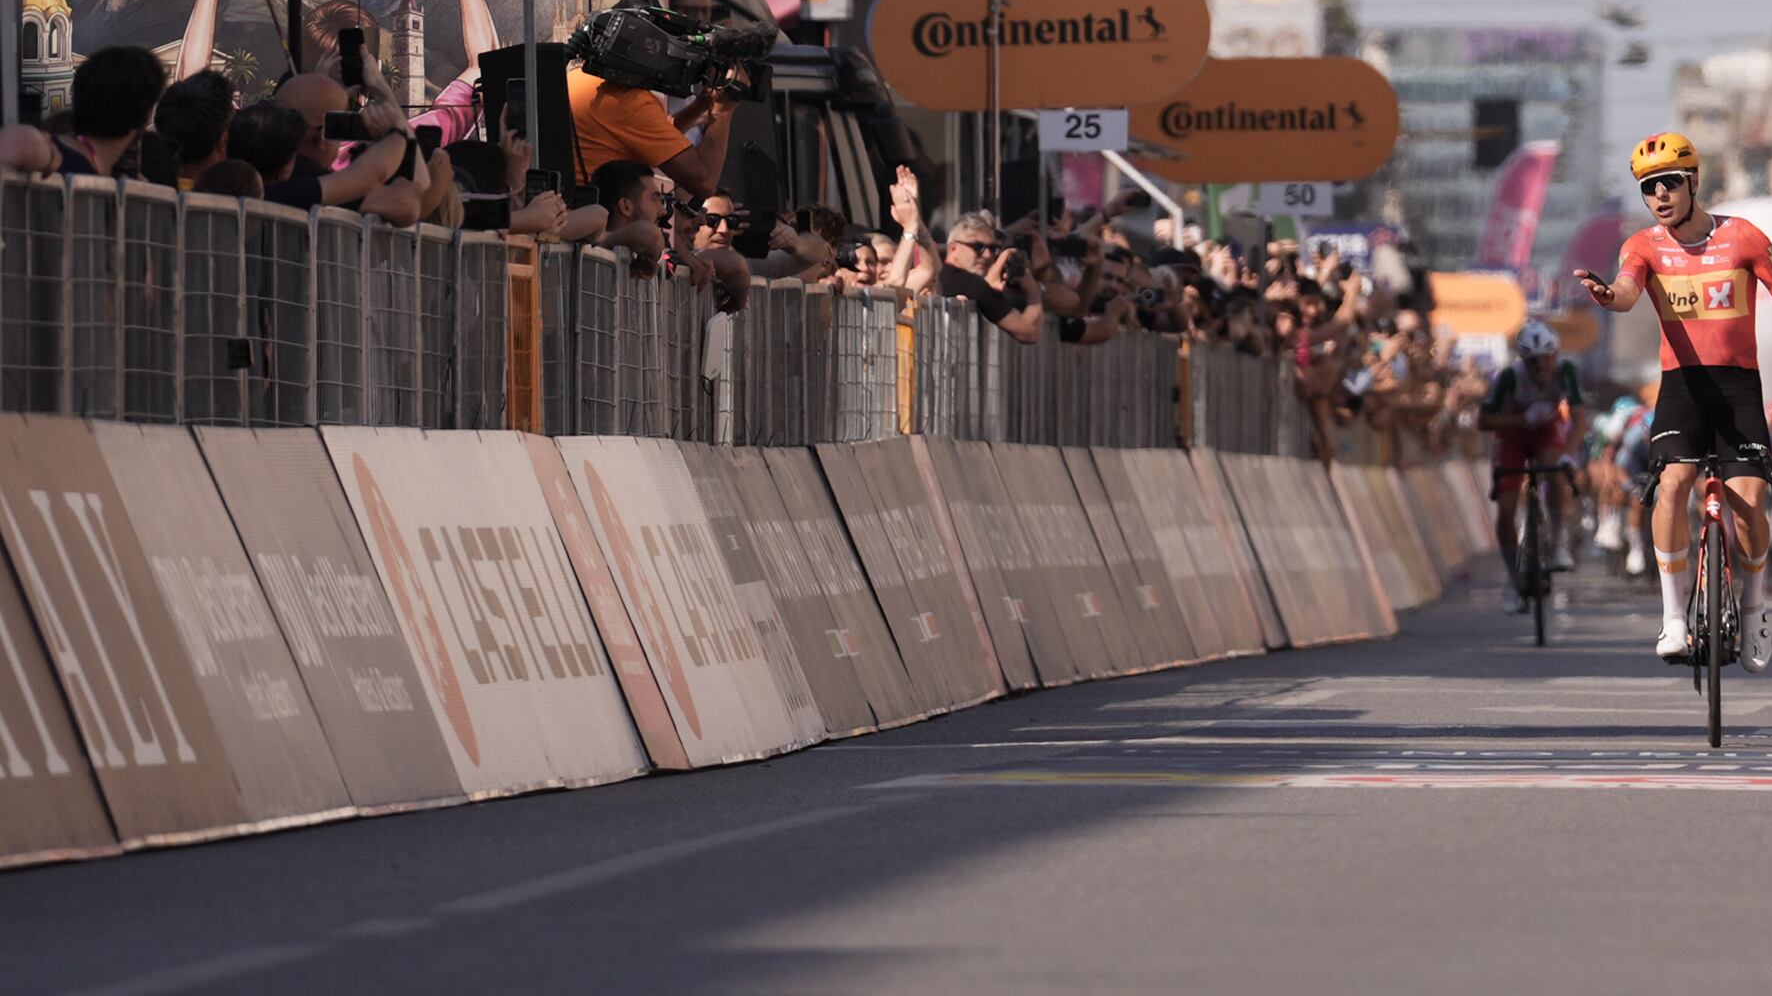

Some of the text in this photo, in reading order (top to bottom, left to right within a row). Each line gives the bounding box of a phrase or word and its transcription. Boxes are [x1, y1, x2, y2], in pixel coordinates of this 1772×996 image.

[911, 8, 1131, 57] Continental
[1064, 113, 1101, 139] 25
[1158, 101, 1338, 138] Continental
[1283, 183, 1315, 206] 50
[1707, 281, 1732, 309] X
[417, 525, 605, 685] CASTELLI
